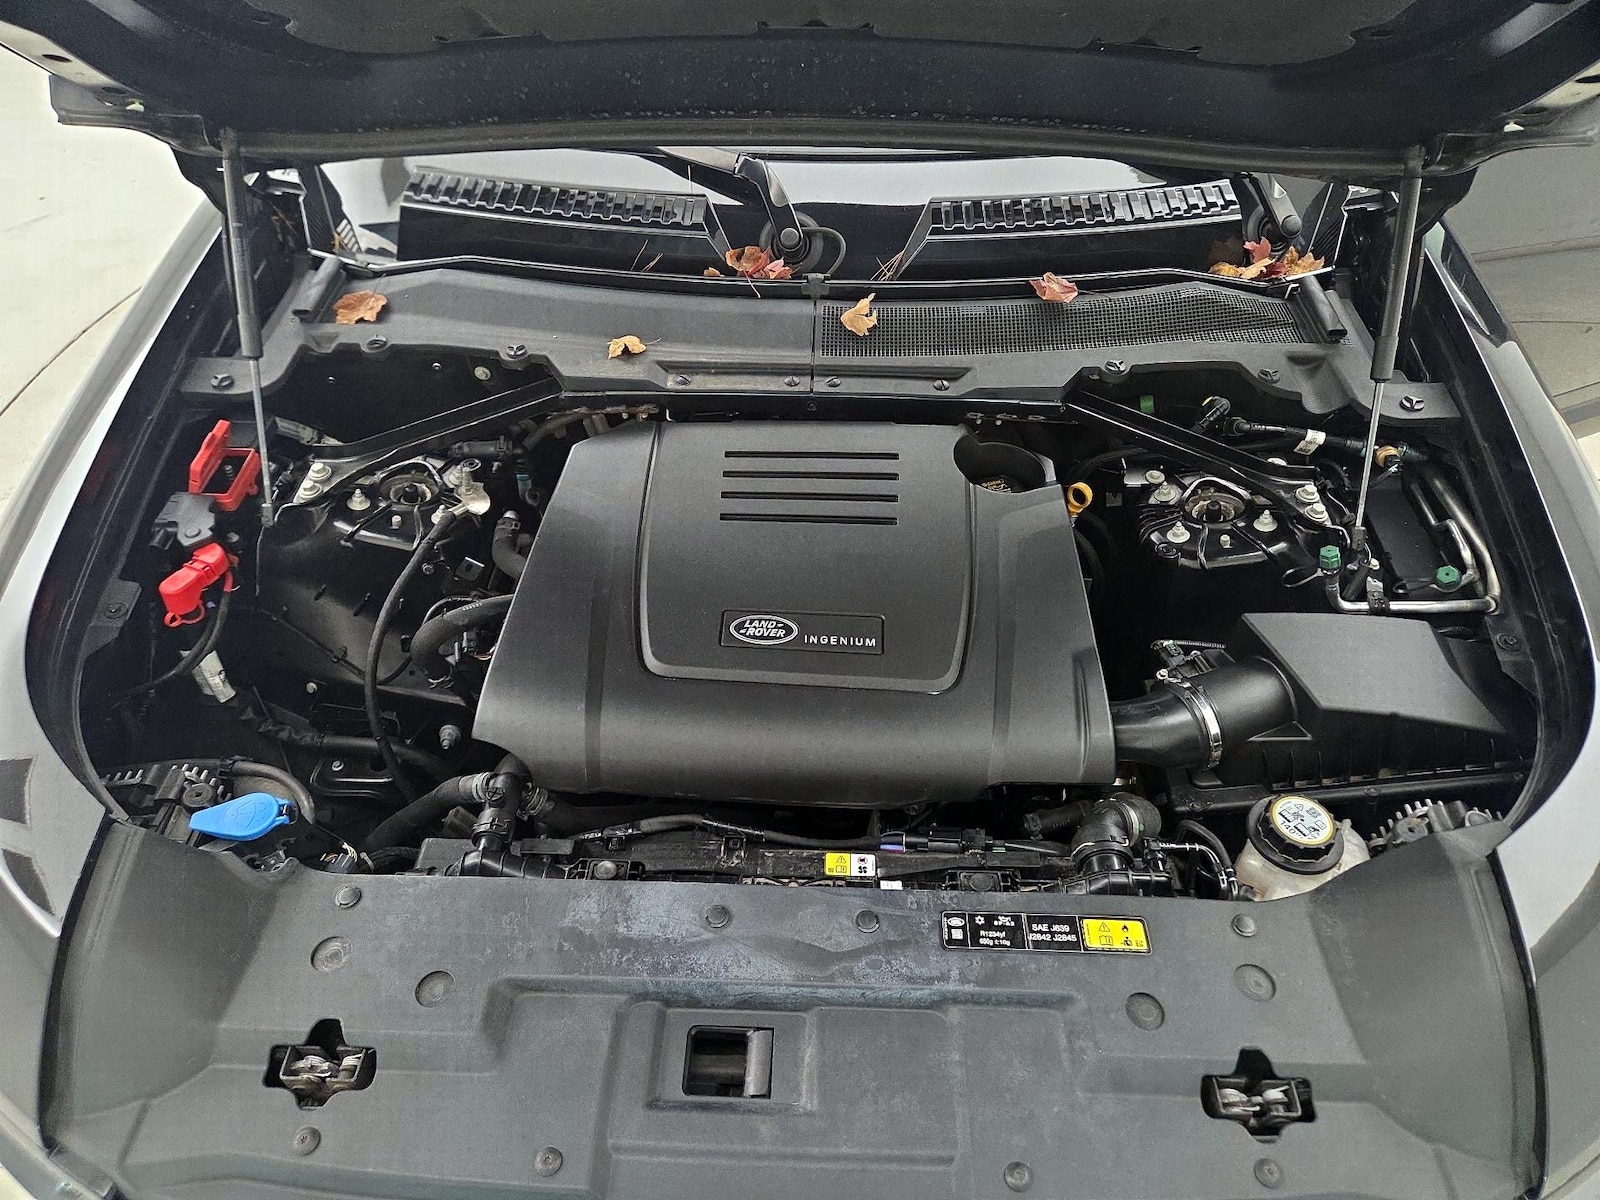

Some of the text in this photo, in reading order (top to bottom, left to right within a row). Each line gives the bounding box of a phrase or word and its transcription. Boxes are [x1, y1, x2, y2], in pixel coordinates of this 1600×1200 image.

[804, 634, 877, 648] INGENIUM
[1031, 923, 1070, 932] SAE J639
[1027, 933, 1077, 942] J2842 J2845
